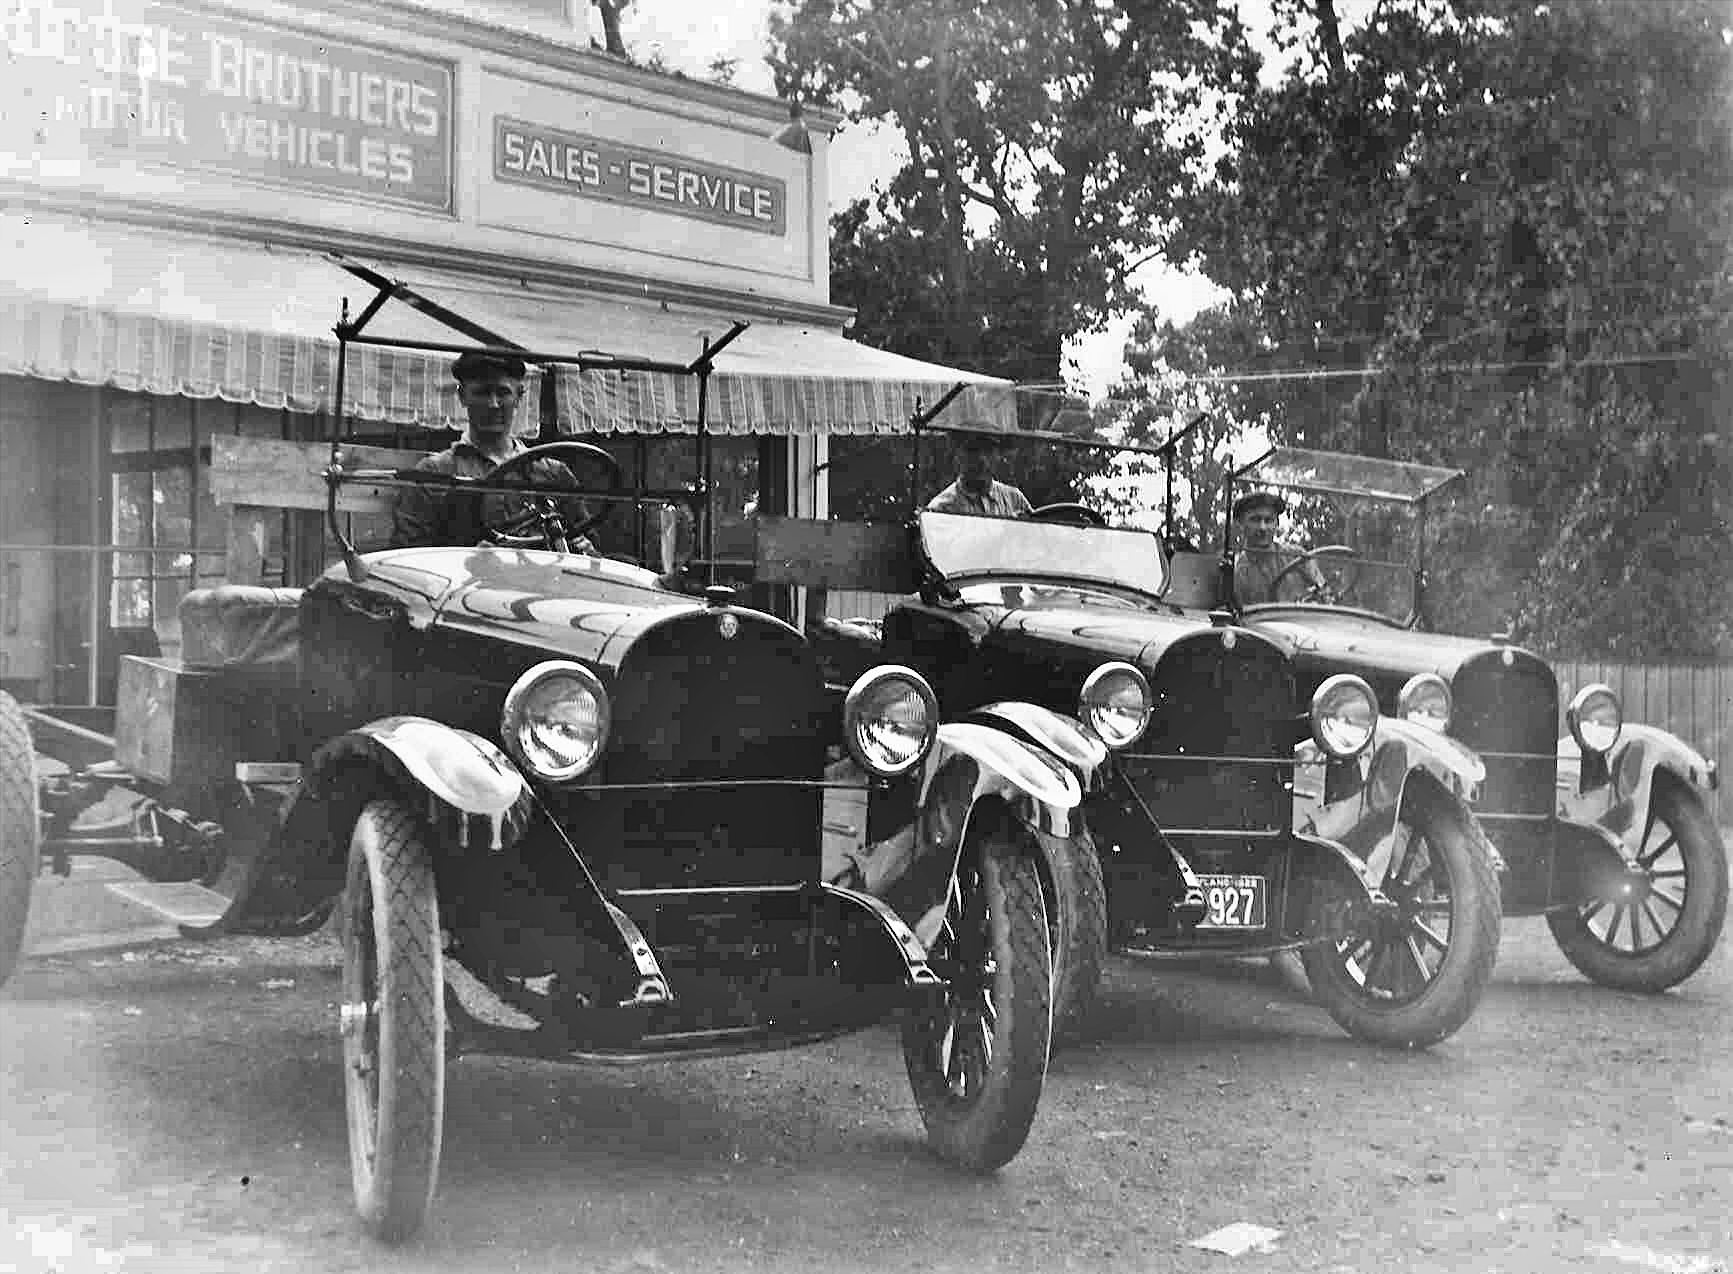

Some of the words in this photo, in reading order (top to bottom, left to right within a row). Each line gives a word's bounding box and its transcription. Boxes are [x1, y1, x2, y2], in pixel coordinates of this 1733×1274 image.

[202, 32, 440, 137] BROTHERS
[218, 111, 415, 184] VEHICLES
[504, 133, 600, 186] SALES
[629, 160, 775, 221] SERVICE
